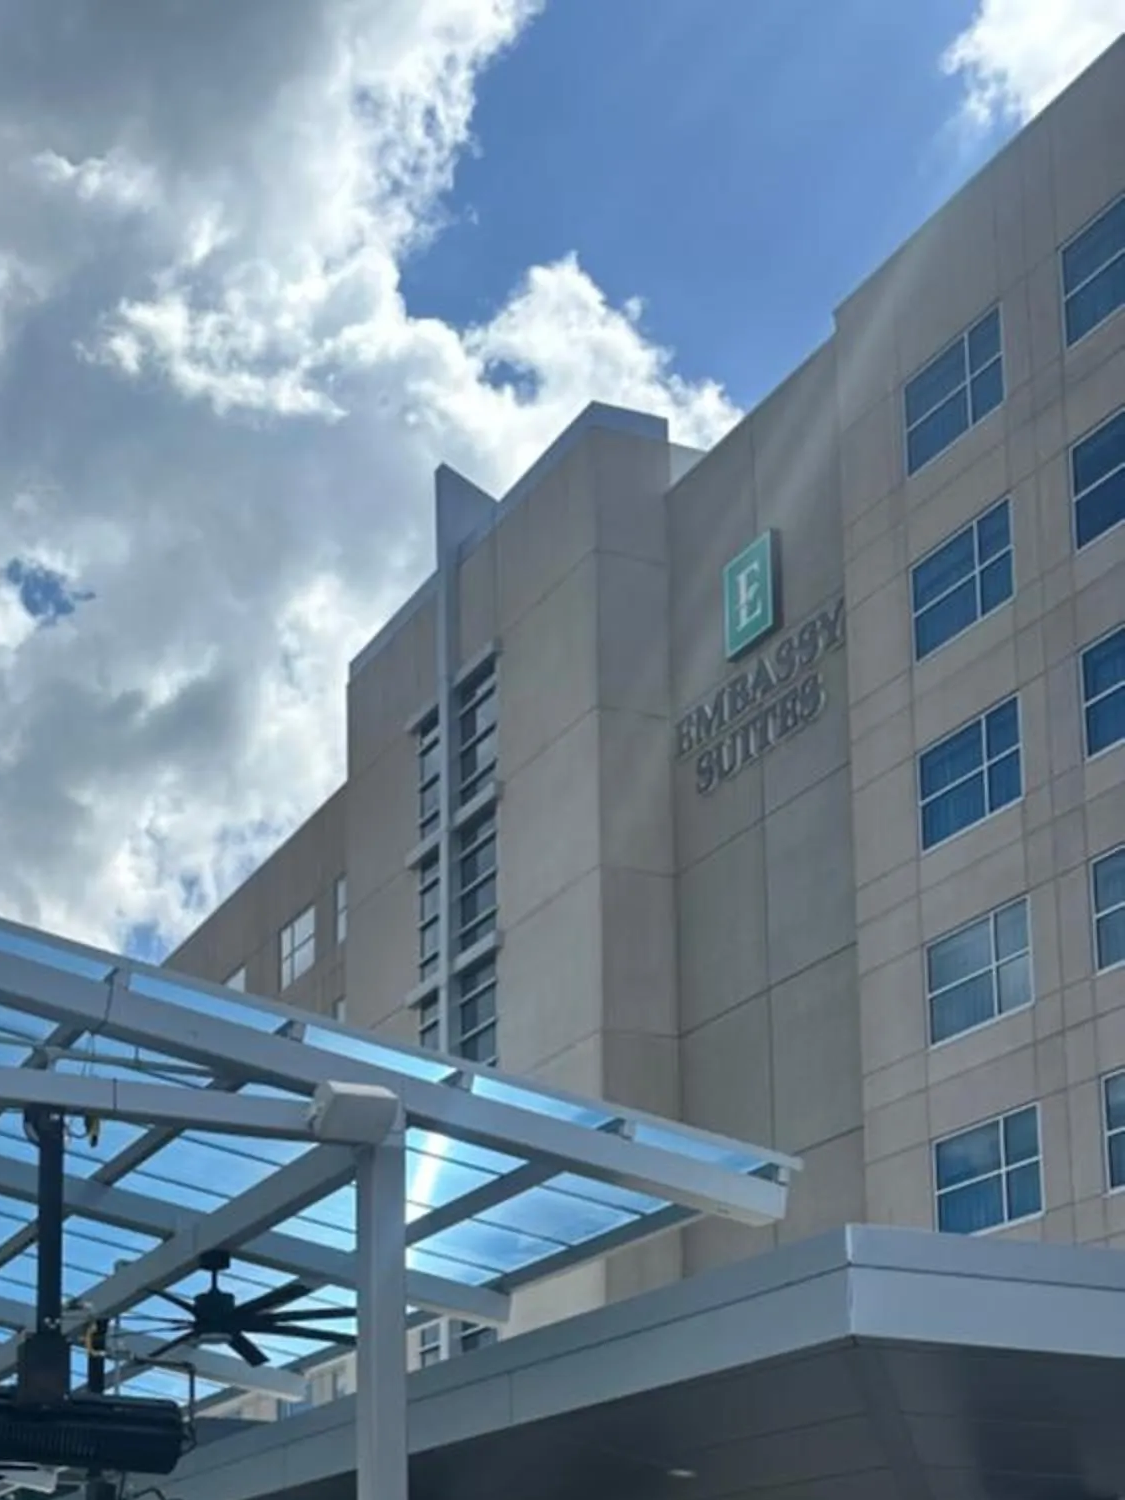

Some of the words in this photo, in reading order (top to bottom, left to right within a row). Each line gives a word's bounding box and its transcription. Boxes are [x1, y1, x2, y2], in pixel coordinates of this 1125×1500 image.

[735, 560, 762, 632] E
[676, 597, 846, 757] EMBASSY
[695, 672, 826, 796] SUITES
